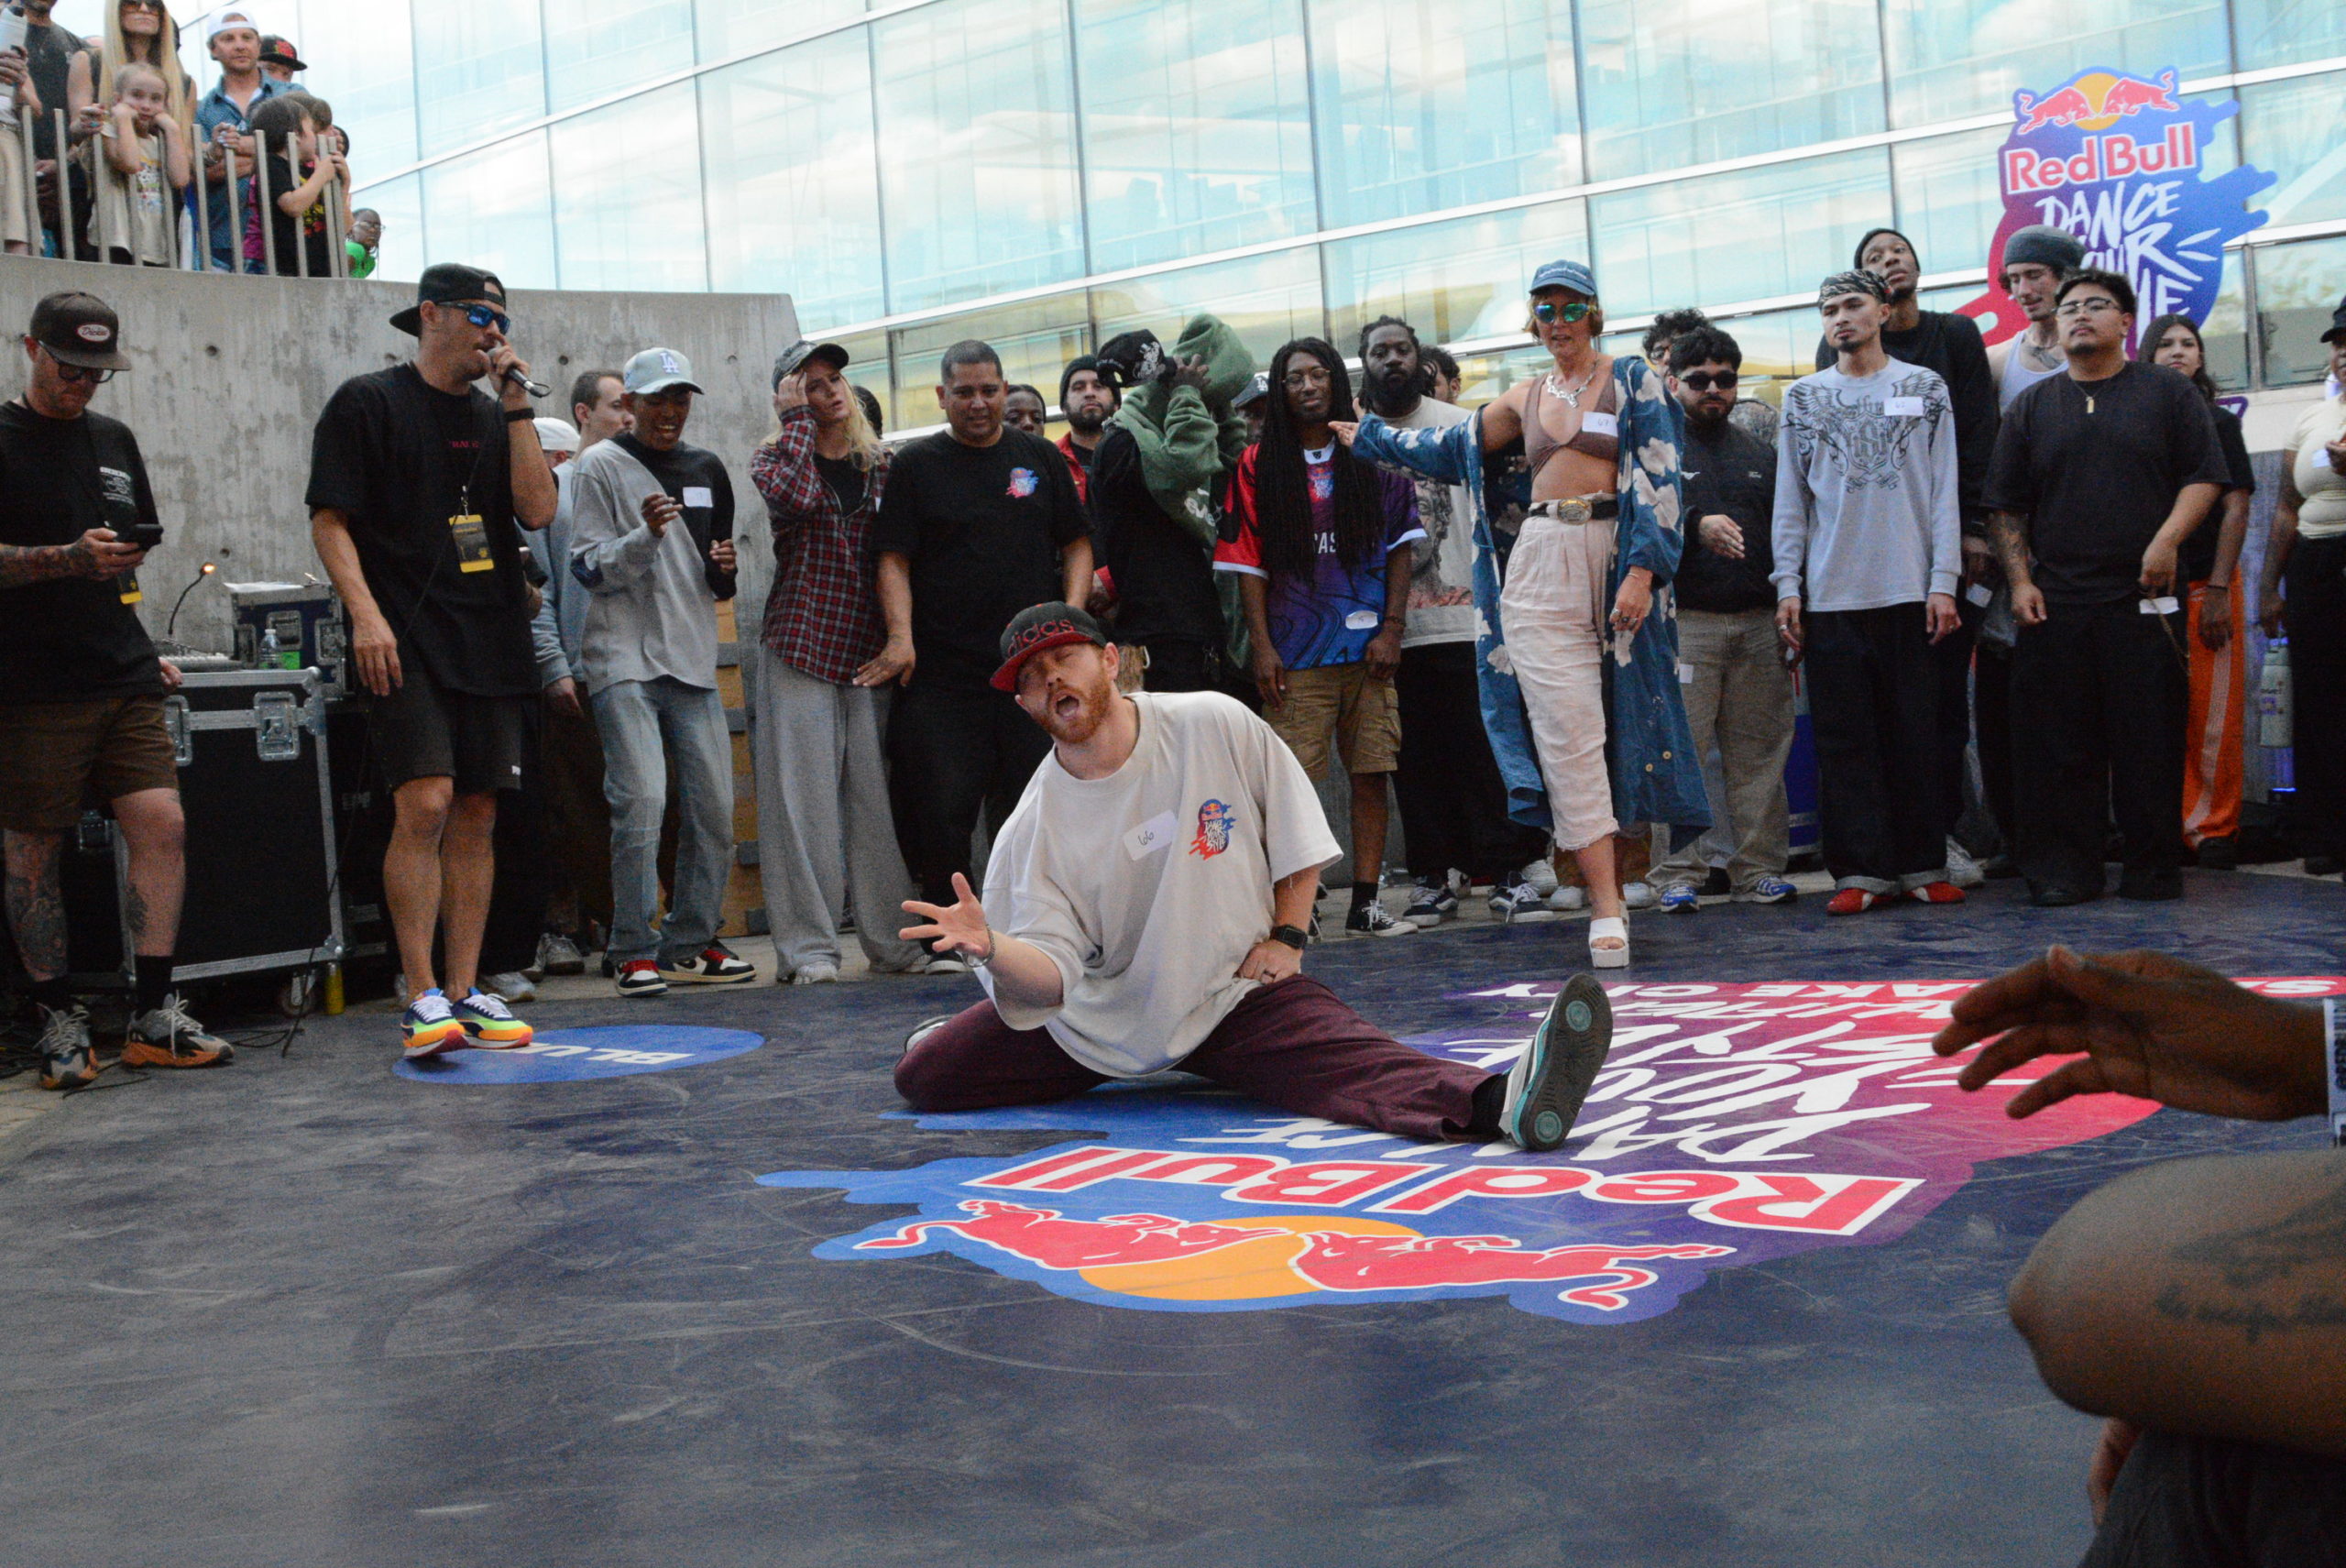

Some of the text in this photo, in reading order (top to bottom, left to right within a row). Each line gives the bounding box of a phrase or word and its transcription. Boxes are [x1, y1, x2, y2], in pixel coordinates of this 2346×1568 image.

[2005, 122, 2197, 194] Red Bull
[2034, 181, 2184, 248] DANCE
[660, 352, 681, 374] LA
[1137, 830, 1155, 846] 66
[1467, 983, 1719, 997] CIY
[1739, 982, 1982, 997] AKE
[958, 1146, 1927, 1236] Red Bull
